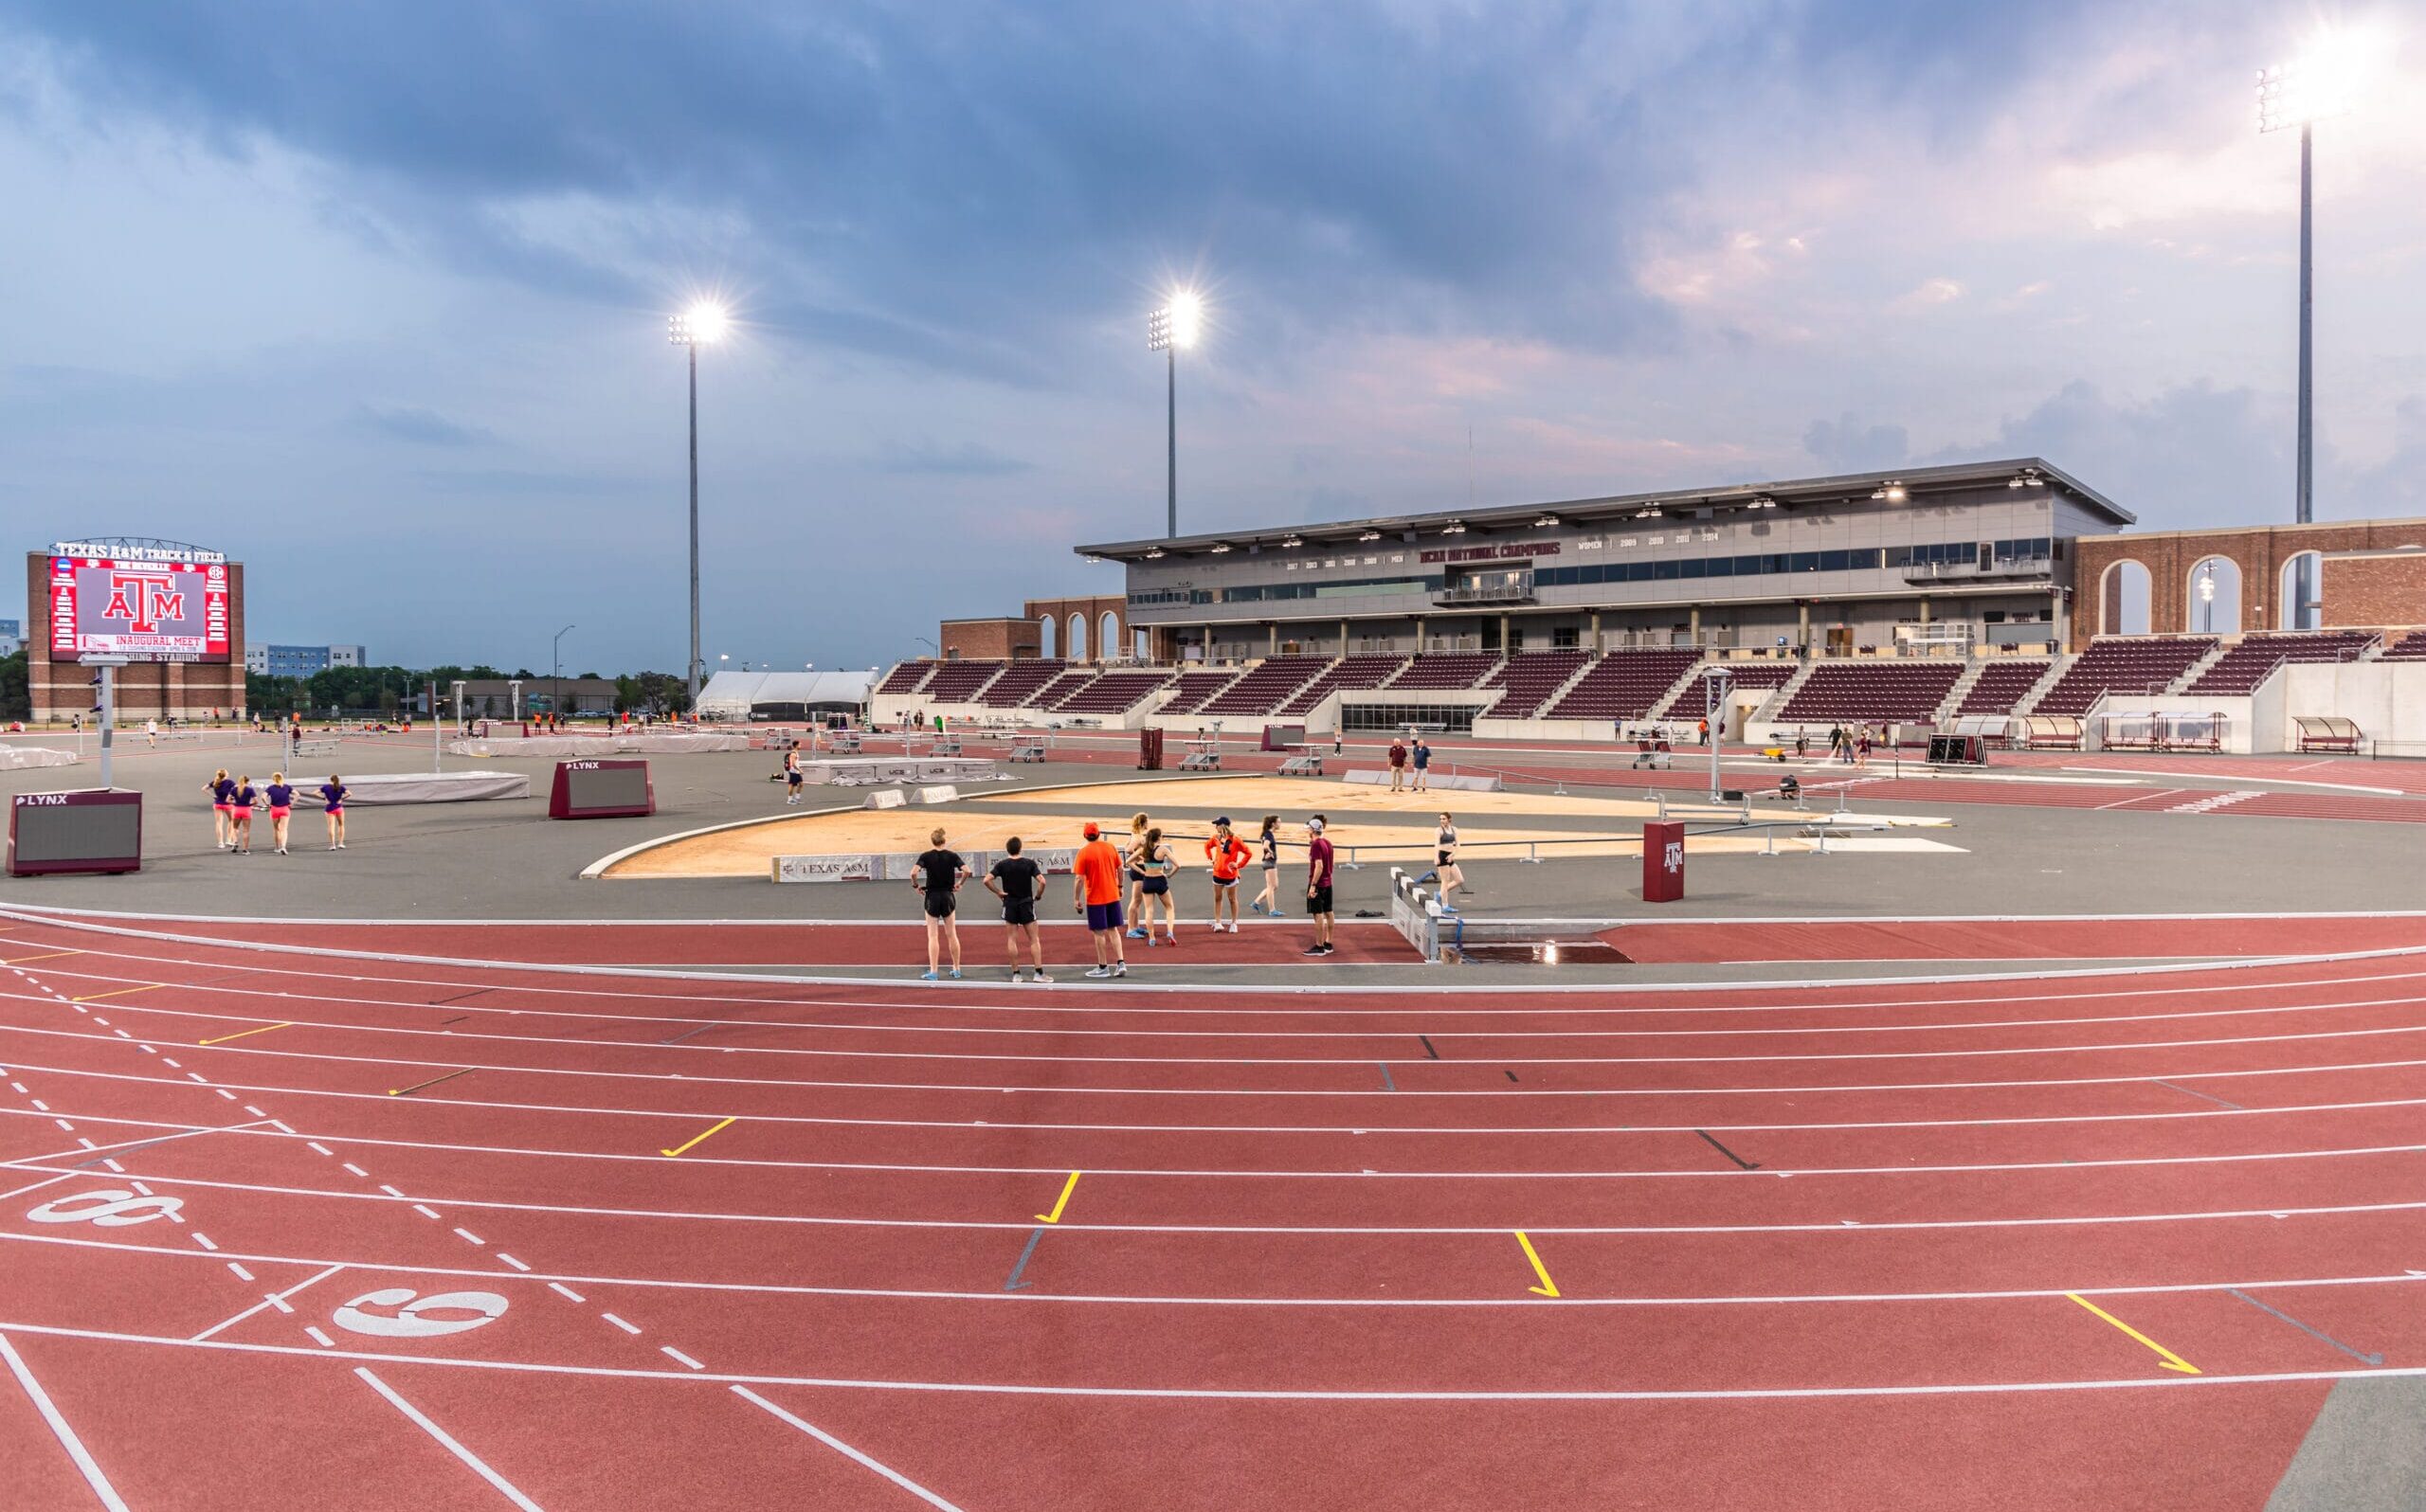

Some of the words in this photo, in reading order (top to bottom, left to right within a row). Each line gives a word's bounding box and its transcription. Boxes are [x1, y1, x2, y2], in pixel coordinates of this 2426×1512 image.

[1578, 541, 1602, 549] WOMEN
[56, 542, 107, 558] TEXAS
[110, 546, 144, 560] A&M
[145, 549, 182, 560] TRACK
[194, 551, 224, 563] FIELD
[1420, 550, 1446, 564] NCAA
[1448, 547, 1498, 562] NATIONAL
[1500, 542, 1561, 557] CHAMPIONS
[116, 636, 171, 646] INAUGURAL
[173, 637, 201, 646] MEET
[155, 654, 200, 662] STADIUM
[572, 762, 599, 770] LYNX
[27, 795, 67, 805] LYNX
[1047, 856, 1071, 866] A&M
[800, 863, 840, 873] TEXAS
[842, 863, 869, 873] A&M
[27, 1189, 185, 1227] 8
